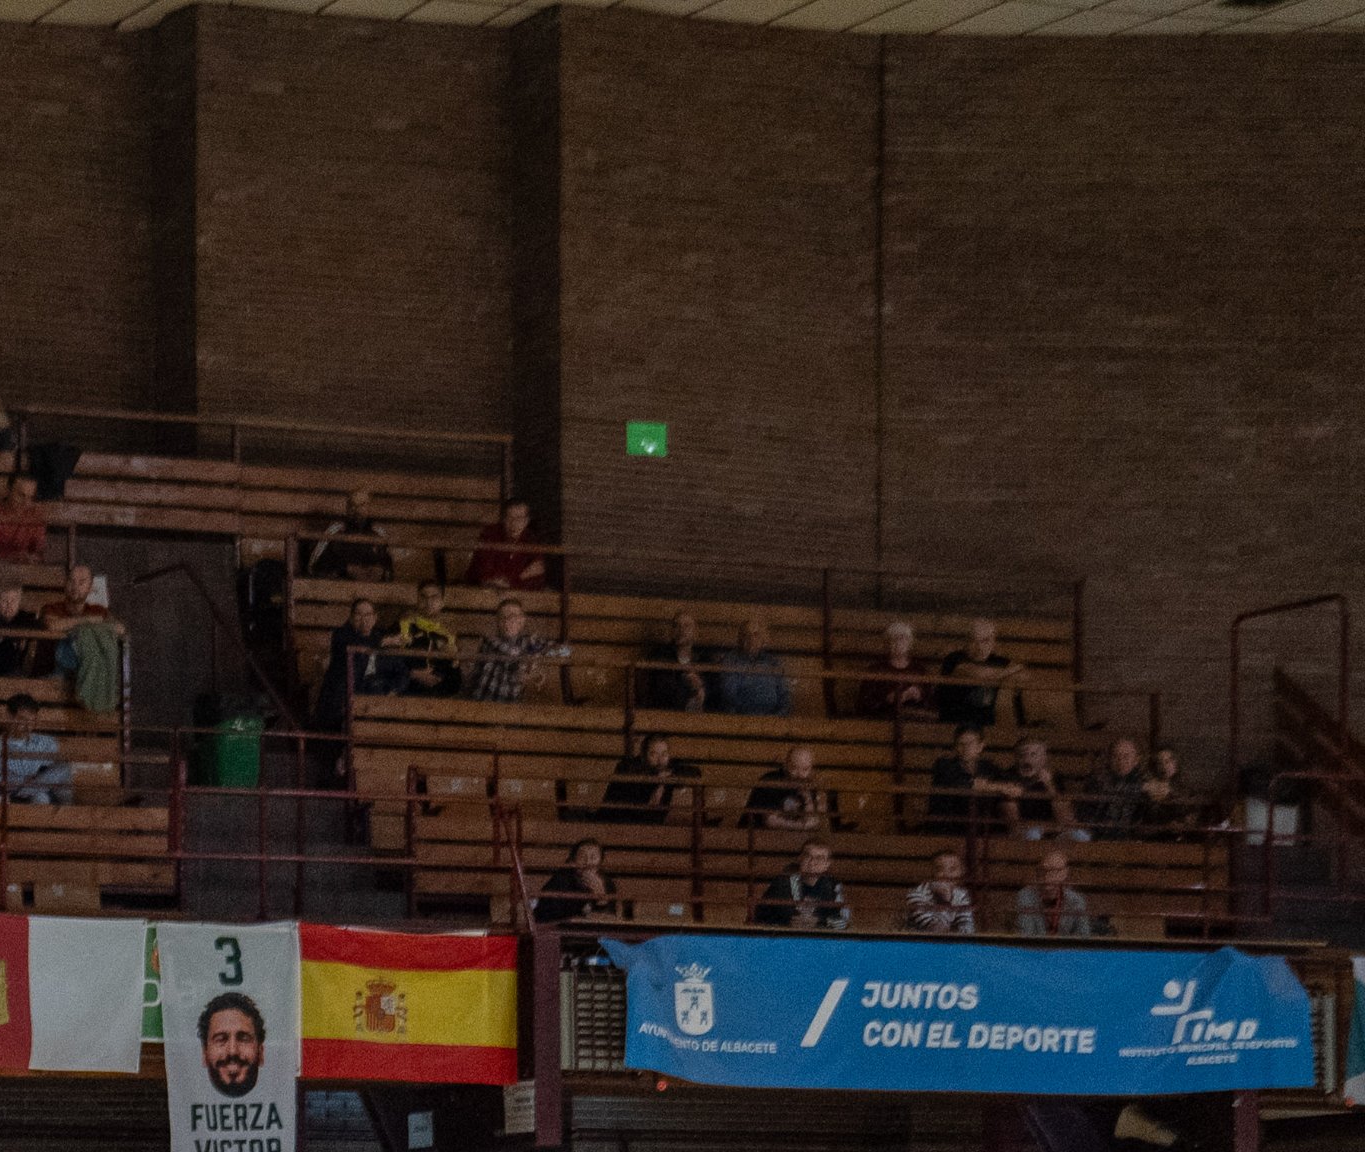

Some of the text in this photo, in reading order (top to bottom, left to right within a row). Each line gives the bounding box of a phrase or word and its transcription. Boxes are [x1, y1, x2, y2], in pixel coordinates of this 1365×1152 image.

[214, 936, 244, 987] 3
[861, 982, 978, 1010] JUNTOS
[701, 1040, 718, 1052] DE
[720, 1041, 778, 1054] ALBACETE
[862, 1020, 1096, 1054] CON EL DEPORTE
[190, 1102, 283, 1133] FUERZA
